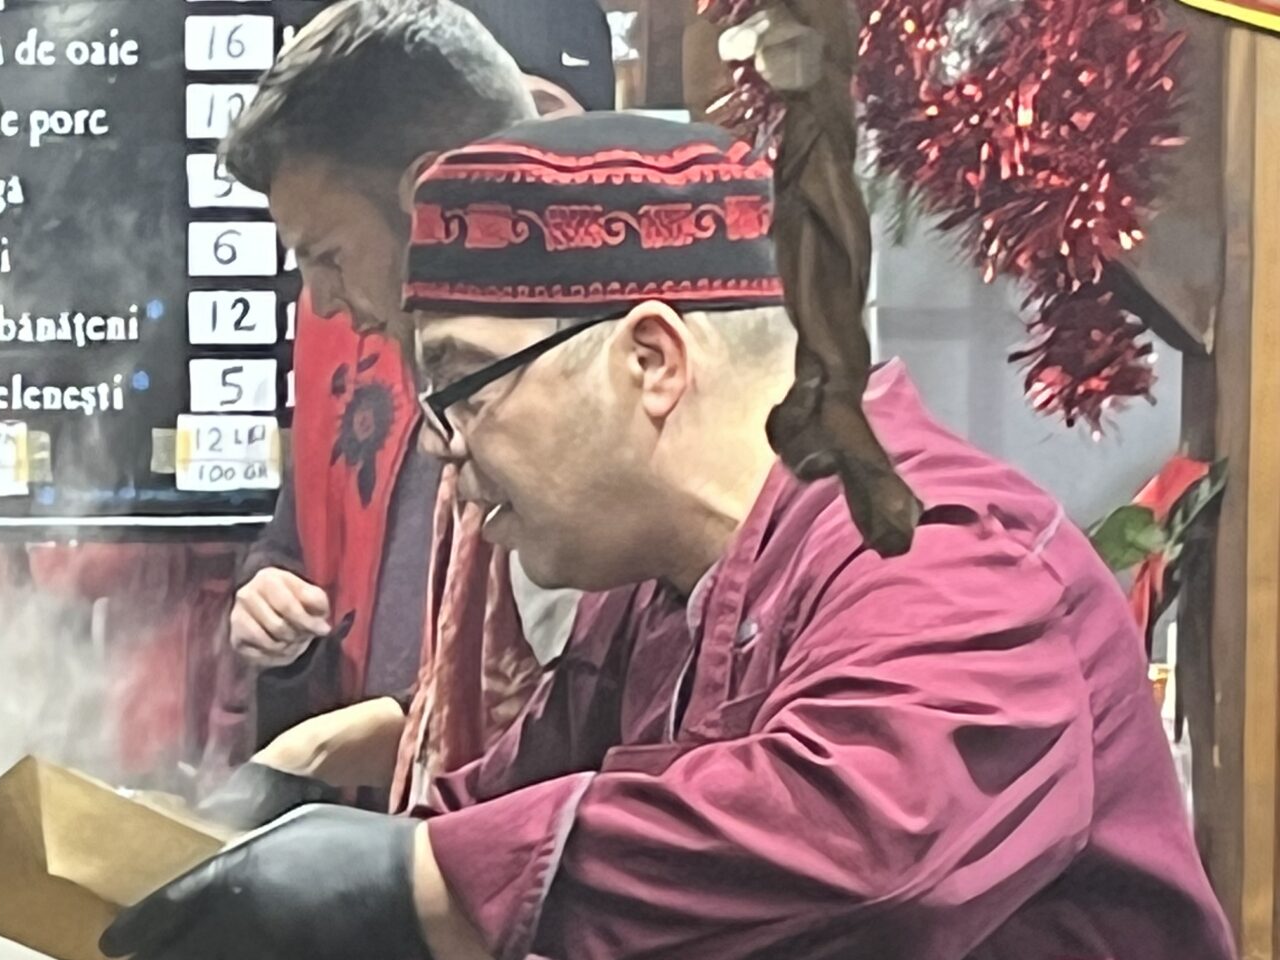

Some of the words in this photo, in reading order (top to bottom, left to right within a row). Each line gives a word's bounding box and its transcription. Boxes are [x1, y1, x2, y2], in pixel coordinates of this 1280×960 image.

[14, 28, 56, 66] de
[66, 28, 139, 66] oaie
[207, 23, 246, 61] 16
[29, 108, 110, 148] porc
[213, 228, 242, 266] 6
[211, 296, 257, 333] 12
[219, 365, 244, 407] 5
[195, 426, 223, 453] 12
[198, 464, 237, 483] 100
